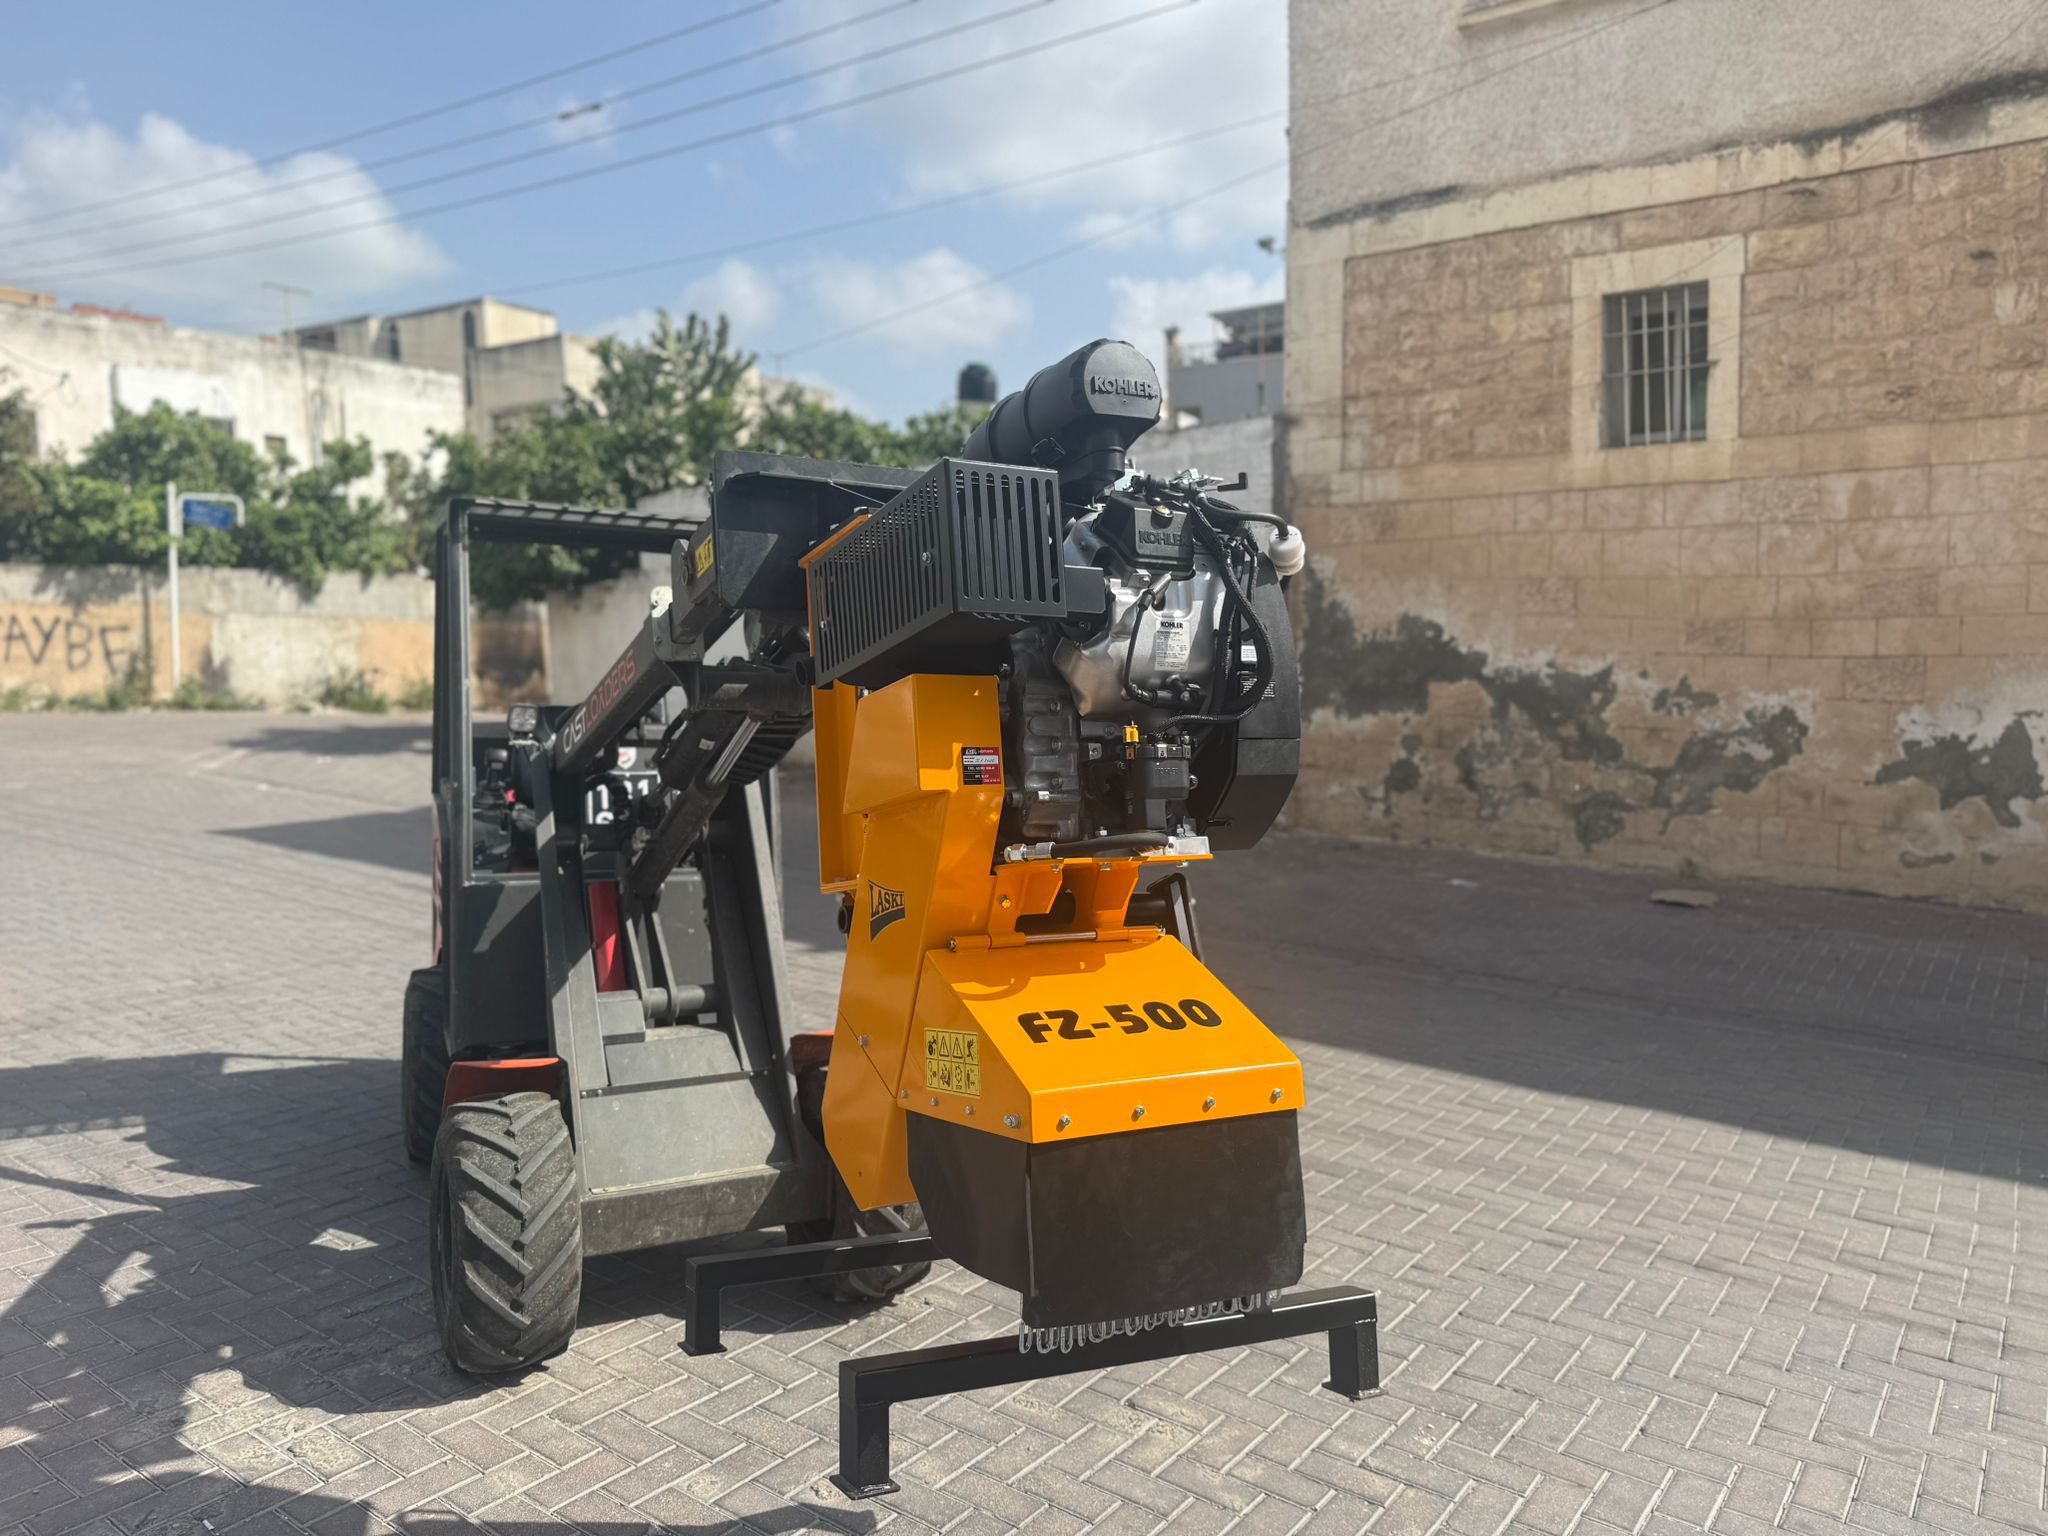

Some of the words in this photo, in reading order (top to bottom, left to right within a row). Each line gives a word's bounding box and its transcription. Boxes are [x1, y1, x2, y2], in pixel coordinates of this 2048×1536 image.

[1090, 375, 1156, 400] KOHLER
[1138, 530, 1189, 547] KOHLER
[1160, 621, 1183, 629] KOHLER
[869, 883, 904, 917] LASKI
[1017, 998, 1222, 1044] FZ-500
